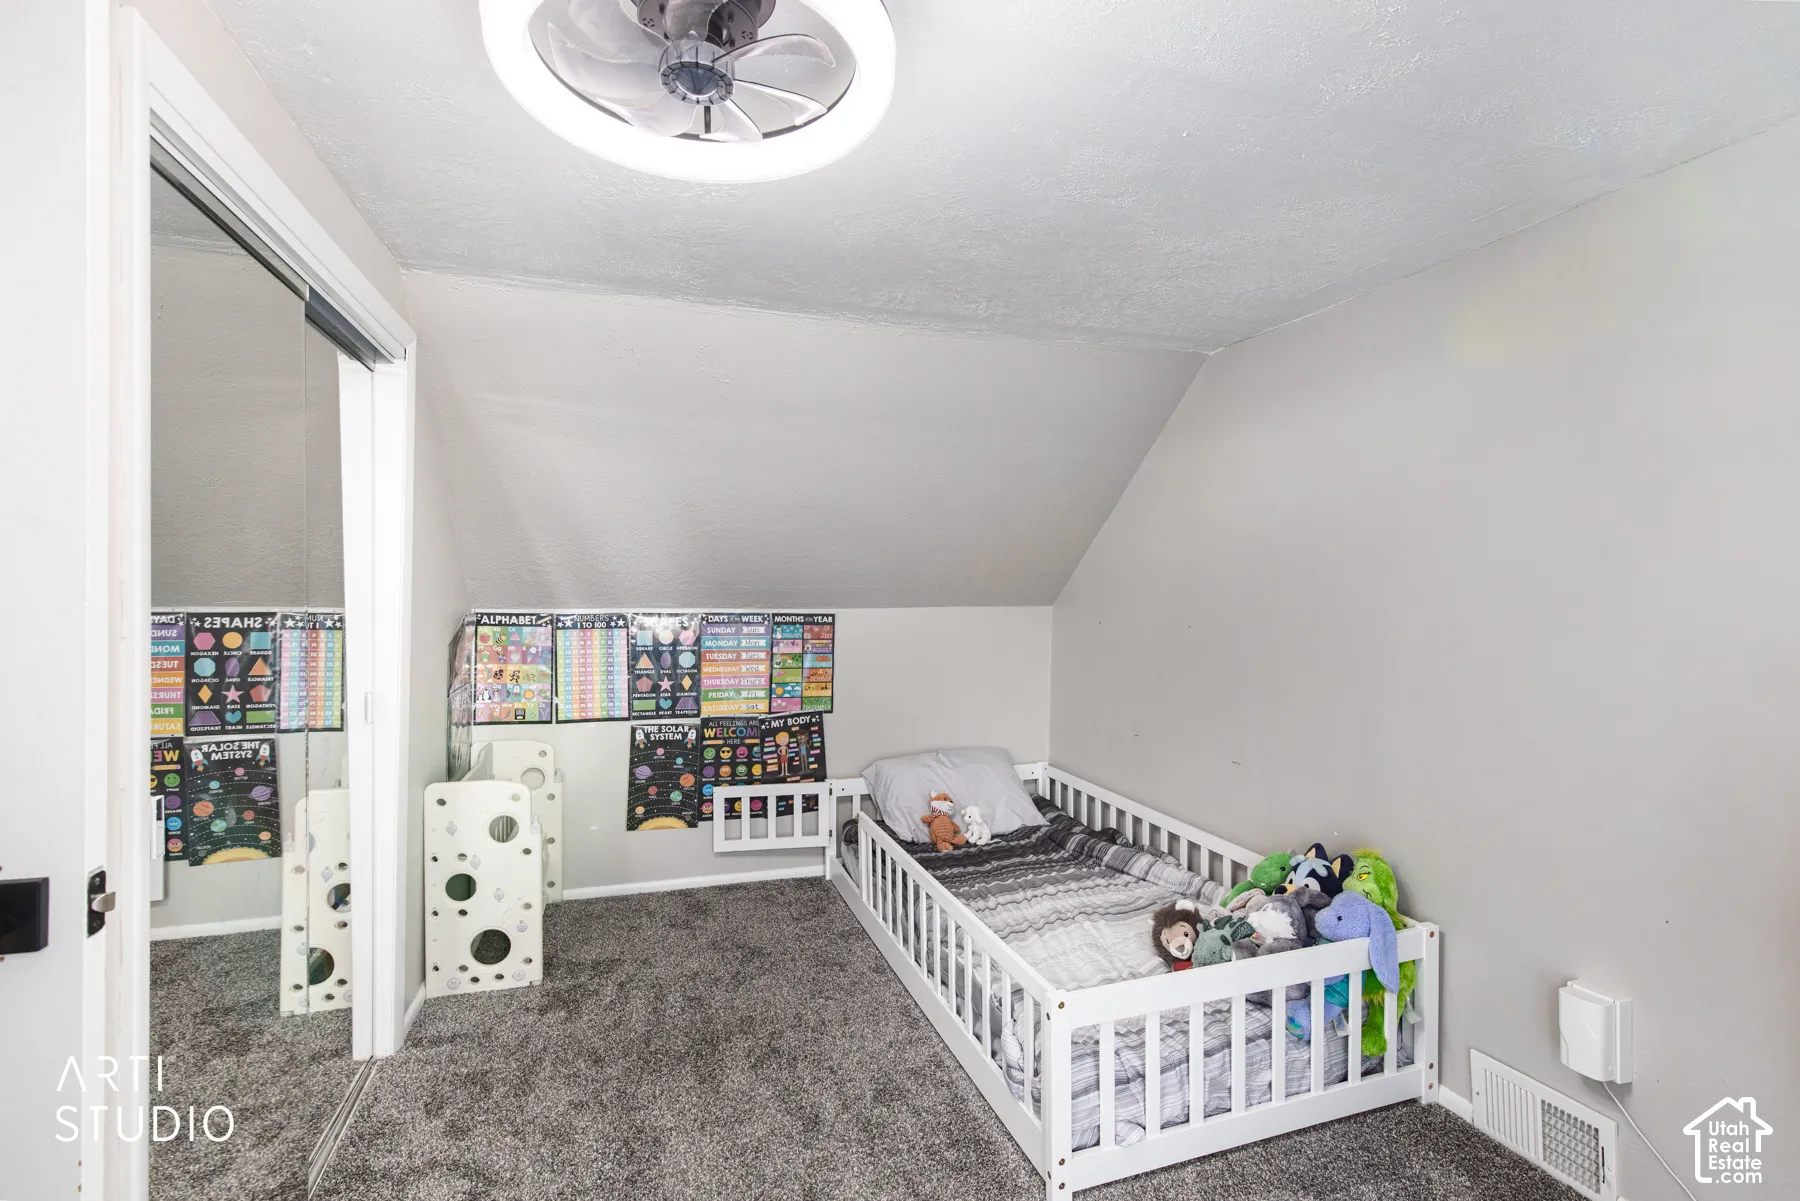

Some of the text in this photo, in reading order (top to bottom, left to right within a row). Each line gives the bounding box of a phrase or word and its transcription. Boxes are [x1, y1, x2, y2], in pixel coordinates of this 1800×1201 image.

[481, 615, 536, 624] ALPHABET
[771, 716, 811, 728] MY BODY
[704, 727, 758, 738] WELCOM
